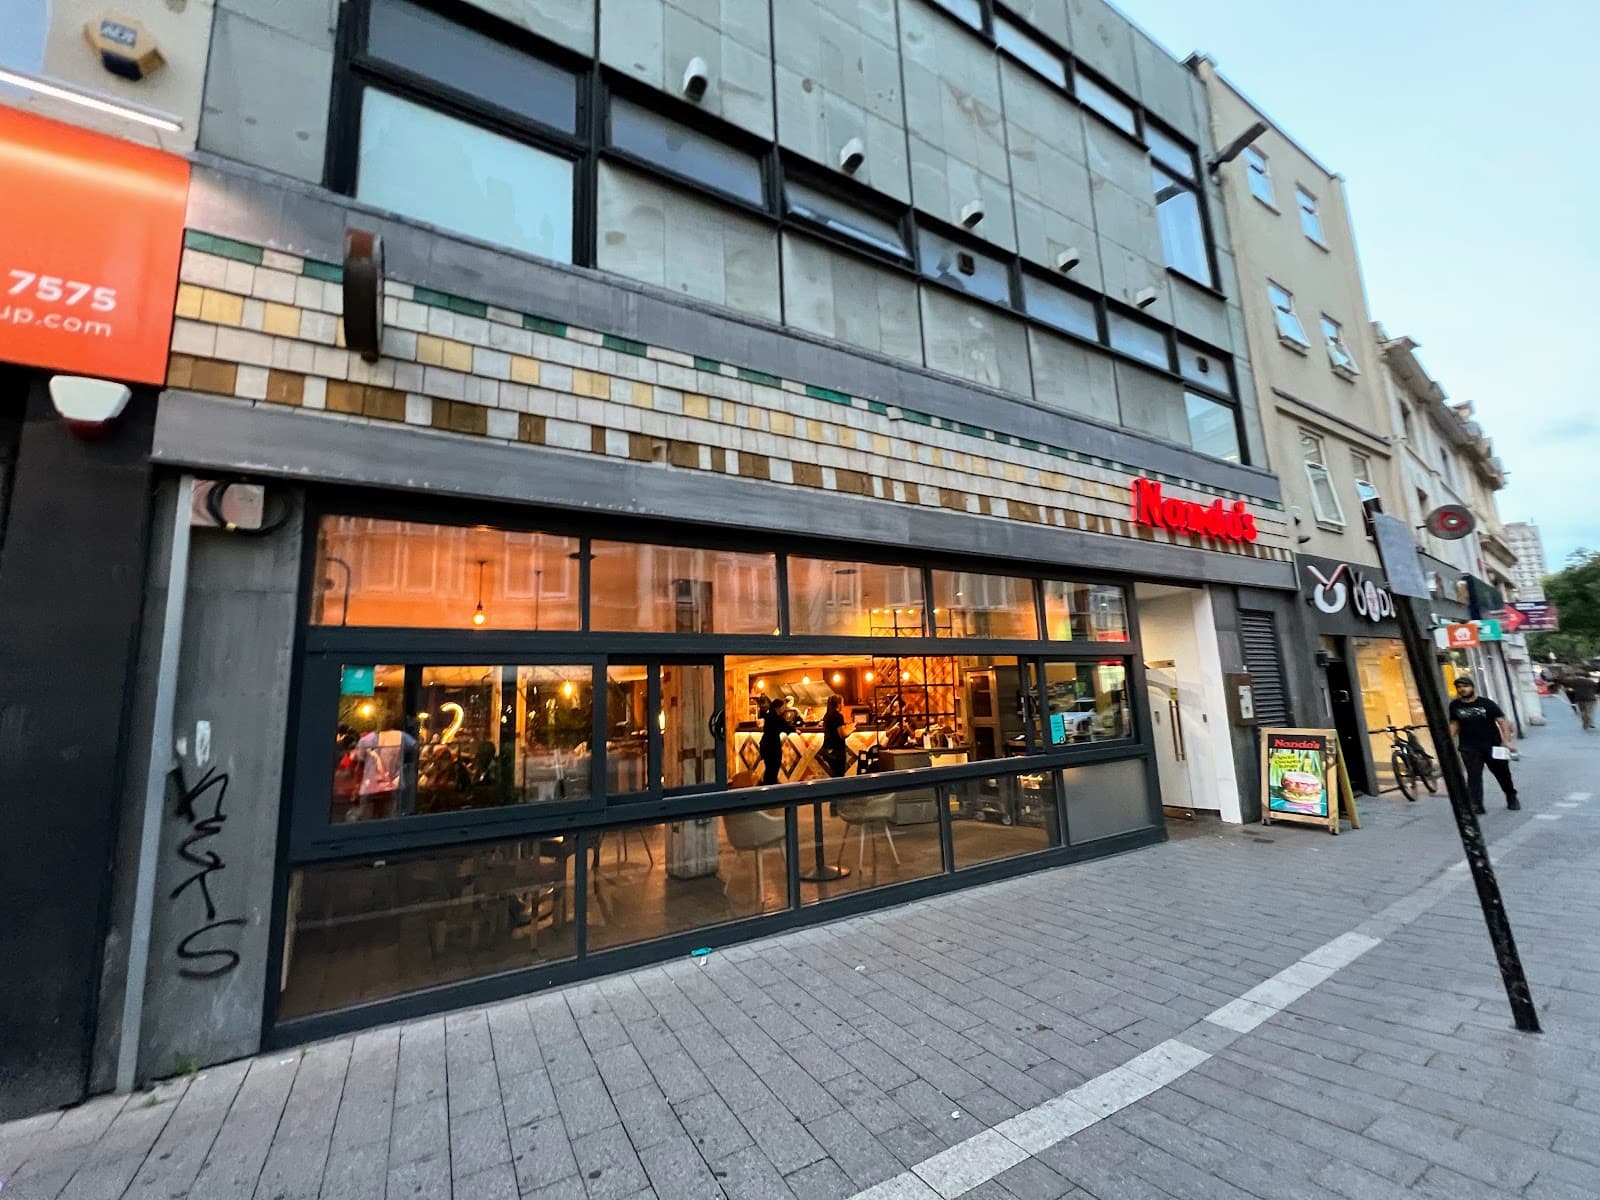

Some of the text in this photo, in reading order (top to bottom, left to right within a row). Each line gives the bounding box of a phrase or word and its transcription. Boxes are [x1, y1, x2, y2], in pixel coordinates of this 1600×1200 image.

[8, 268, 117, 312] 7575
[1134, 477, 1257, 541] Nando's
[1274, 739, 1320, 749] Nando's
